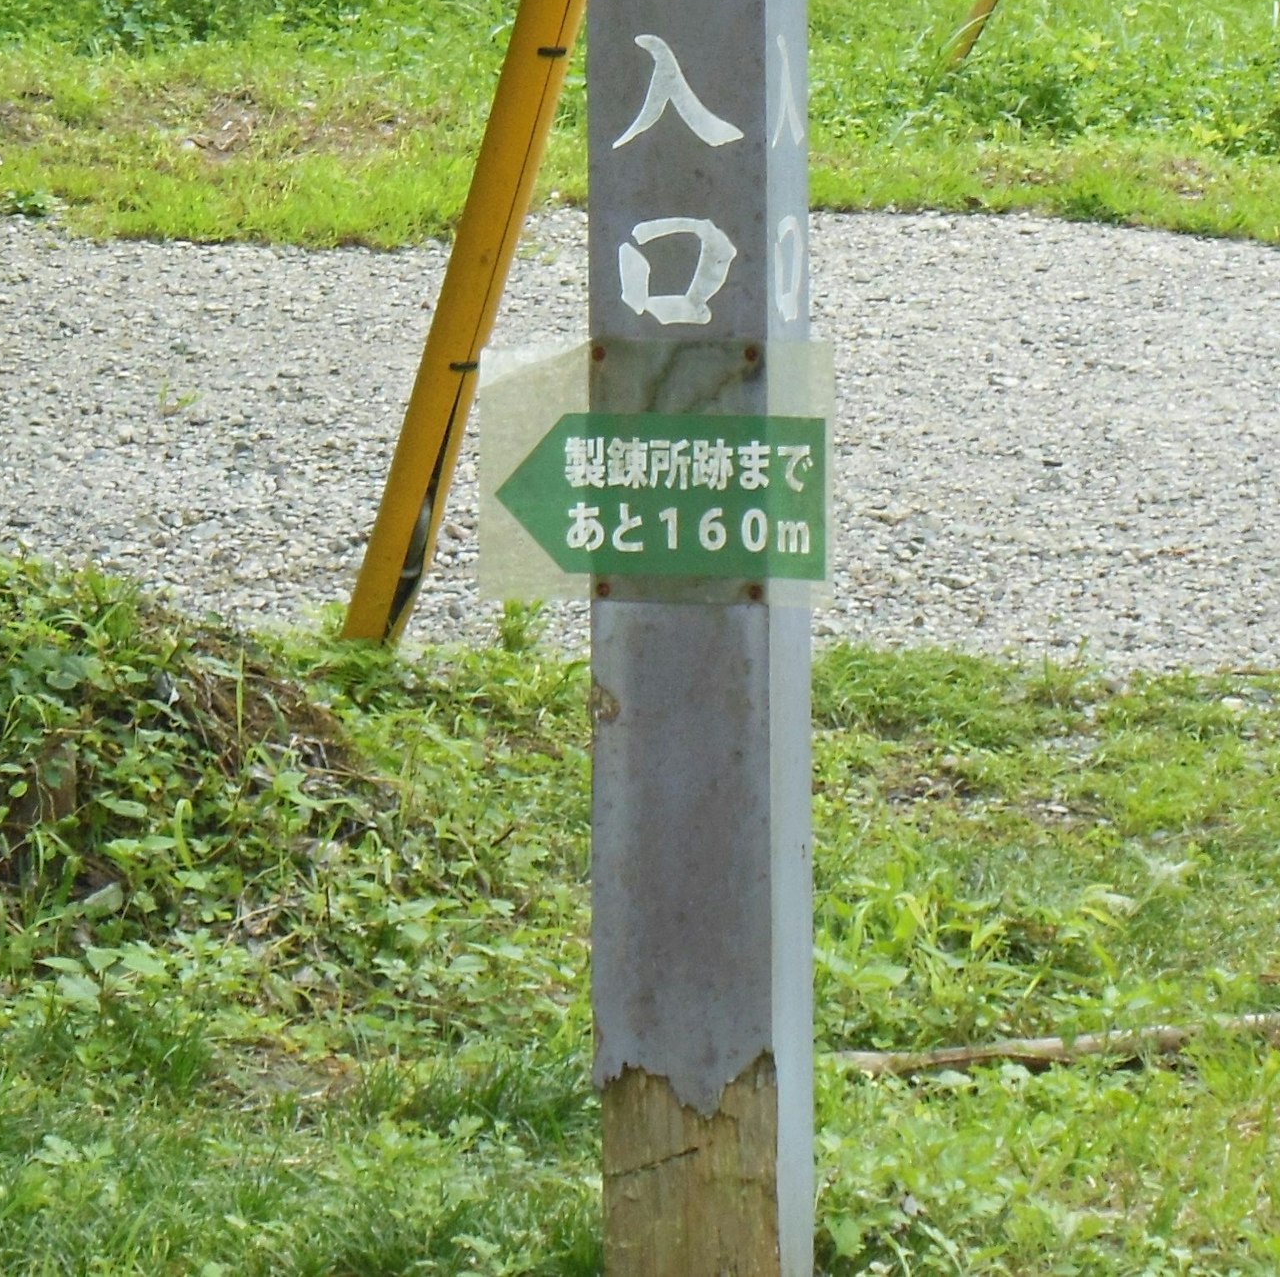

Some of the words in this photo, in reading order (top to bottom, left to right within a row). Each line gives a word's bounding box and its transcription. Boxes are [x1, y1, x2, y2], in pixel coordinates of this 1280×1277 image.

[564, 436, 813, 493] 製錬所跡まで
